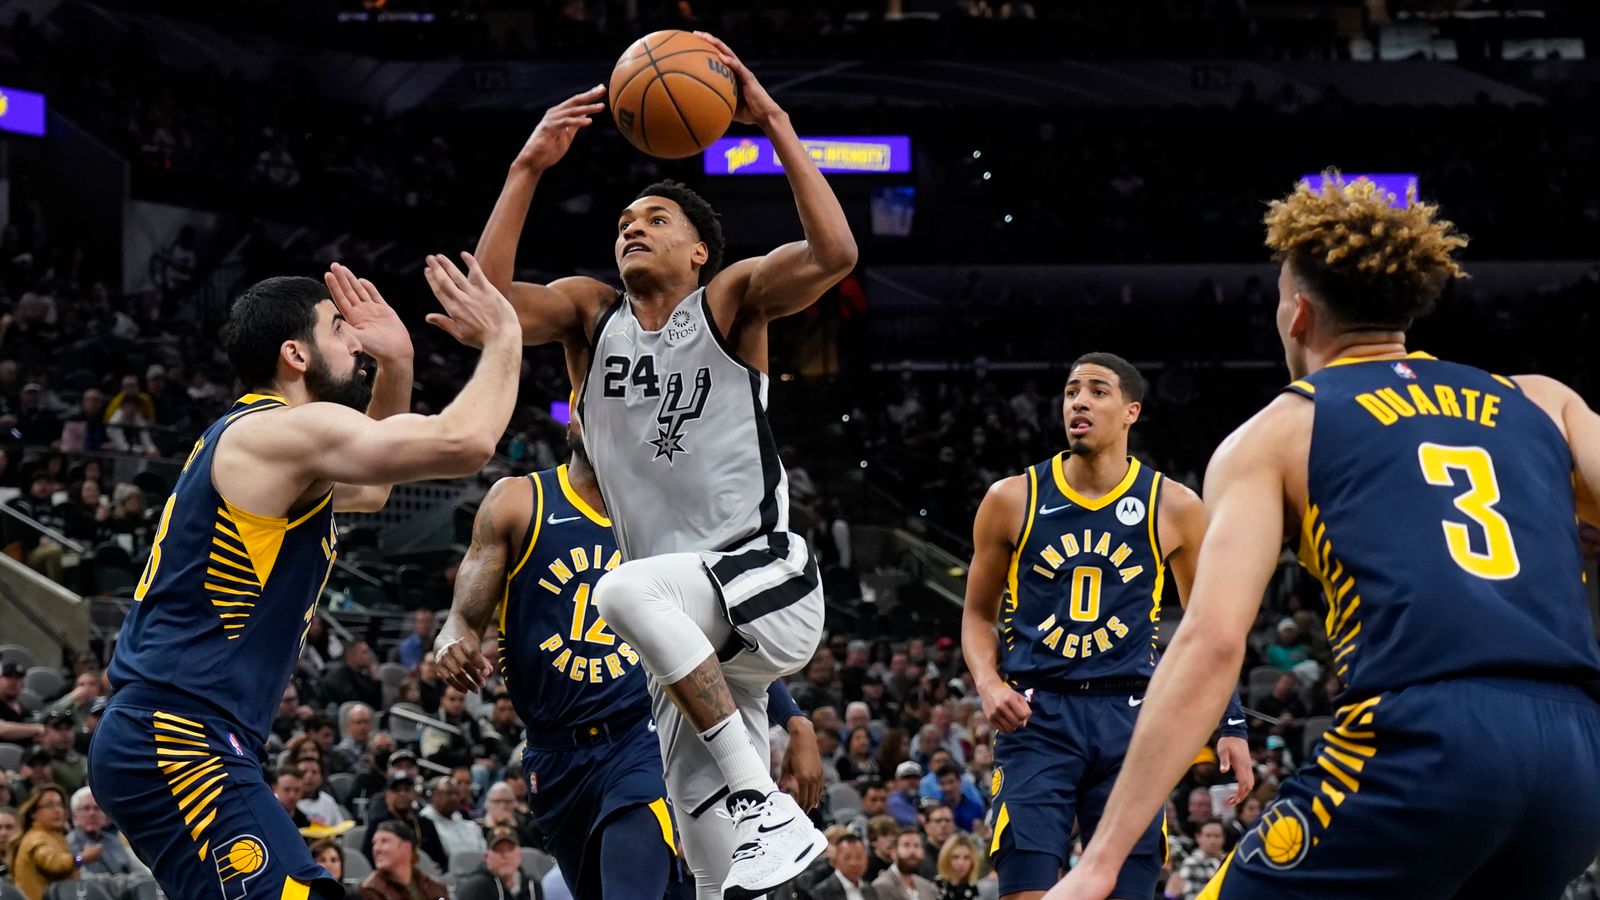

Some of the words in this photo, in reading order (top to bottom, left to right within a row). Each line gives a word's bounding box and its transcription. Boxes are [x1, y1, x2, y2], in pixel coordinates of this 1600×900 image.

[667, 323, 698, 341] Frost
[603, 354, 661, 399] 24
[1355, 384, 1501, 428] DUARTE
[1418, 442, 1520, 580] 3
[538, 544, 622, 595] INDIA
[1032, 529, 1144, 585] INDIANA
[1069, 565, 1103, 622] 0
[539, 632, 640, 684] PACERS
[1037, 613, 1130, 659] PACERS
